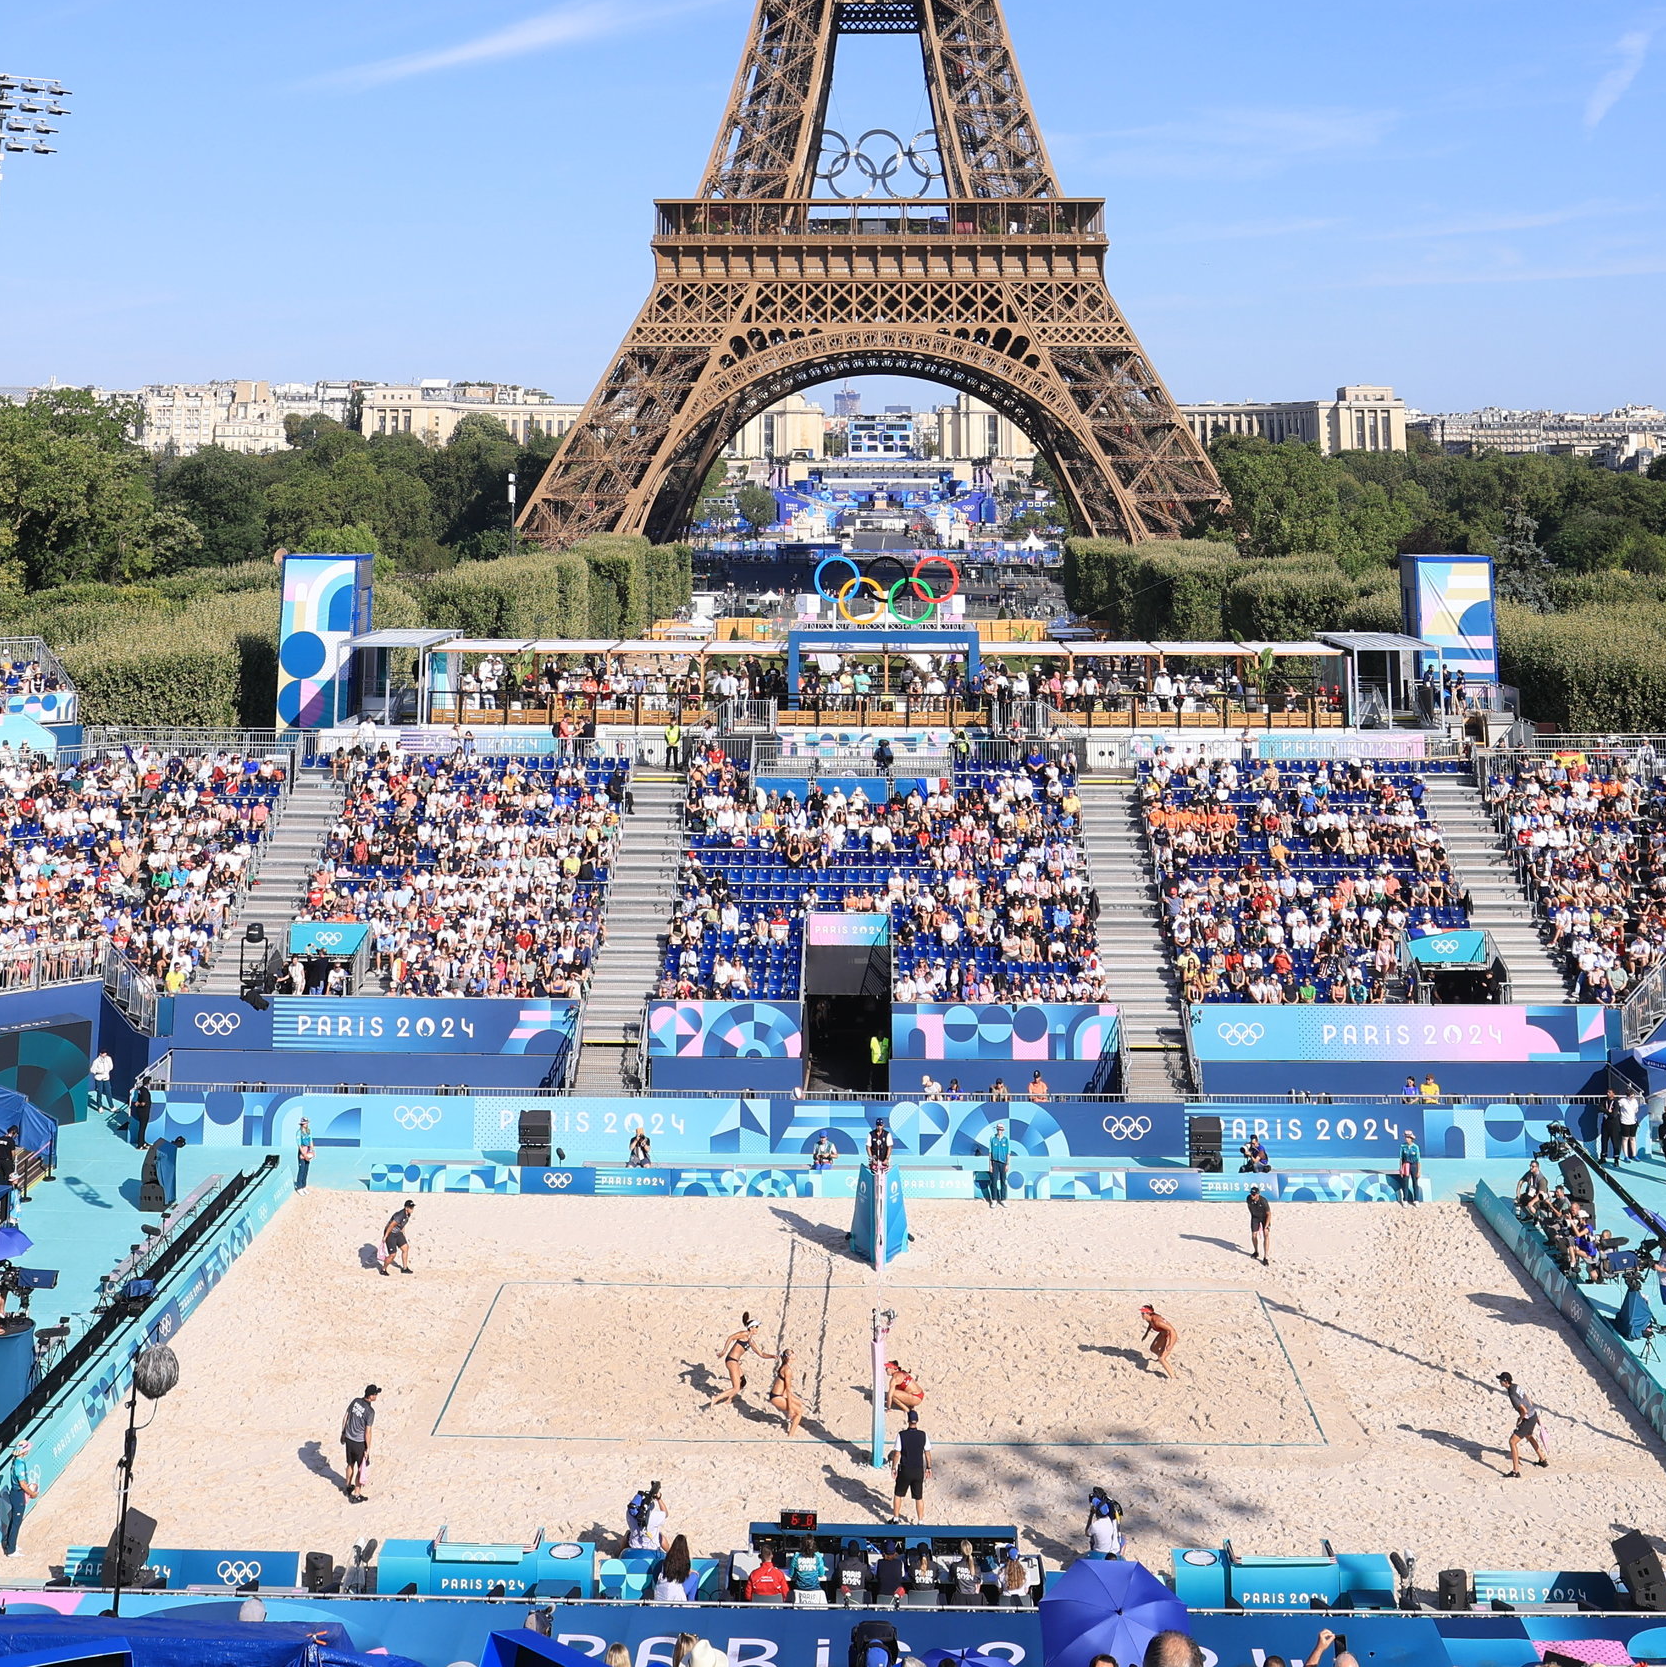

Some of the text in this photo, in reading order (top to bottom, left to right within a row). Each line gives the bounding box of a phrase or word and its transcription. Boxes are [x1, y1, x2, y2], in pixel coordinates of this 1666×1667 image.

[396, 1016, 474, 1038] 2024
[1423, 1024, 1502, 1045] 2024
[603, 1112, 684, 1135] 2024
[1316, 1118, 1399, 1141] 2024
[636, 1177, 666, 1186] 2024
[1542, 1587, 1587, 1601] 2024
